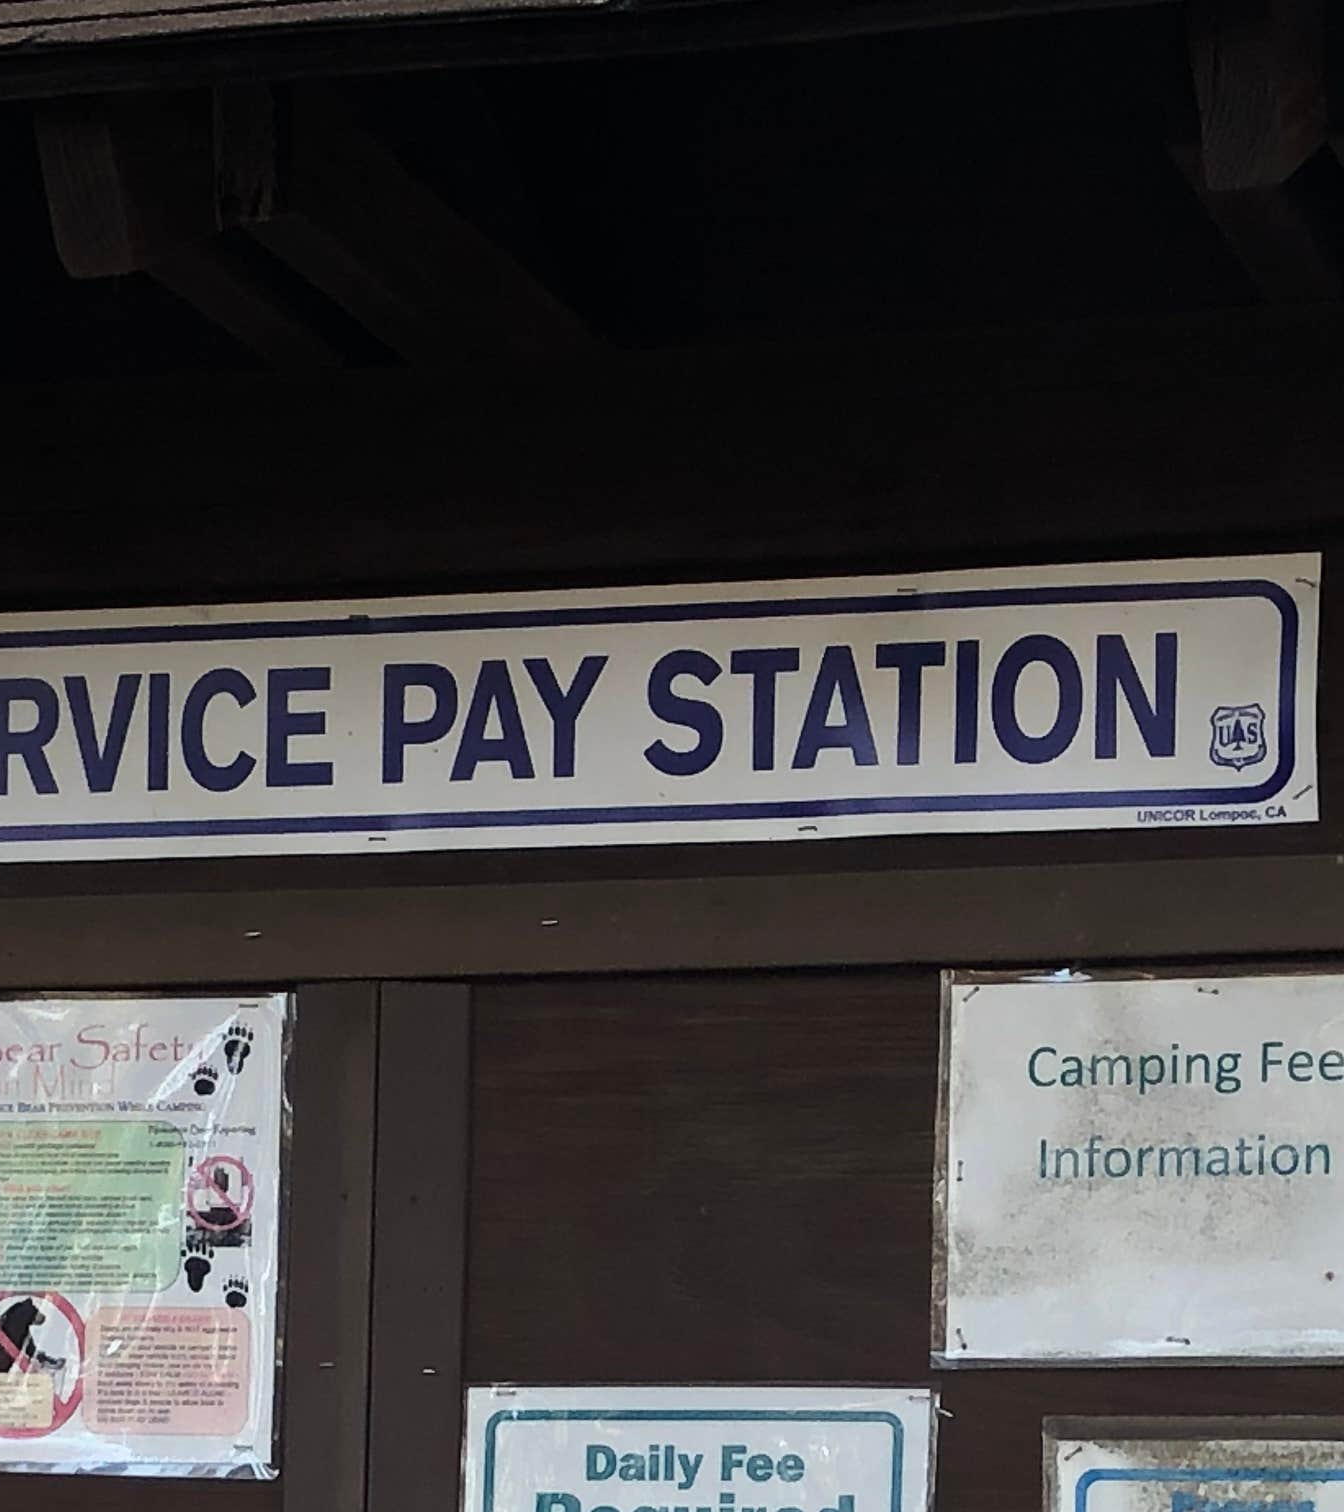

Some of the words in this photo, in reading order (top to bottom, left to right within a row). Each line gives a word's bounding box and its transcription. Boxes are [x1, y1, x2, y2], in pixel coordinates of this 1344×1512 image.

[381, 655, 609, 785] PAY
[644, 632, 1178, 778] STATION
[1137, 810, 1196, 823] UNICOR
[1265, 806, 1287, 819] CA
[1028, 1042, 1242, 1094] Camping
[1039, 1134, 1332, 1179] Information
[585, 1444, 703, 1490] Daily
[720, 1445, 806, 1483] Fee
